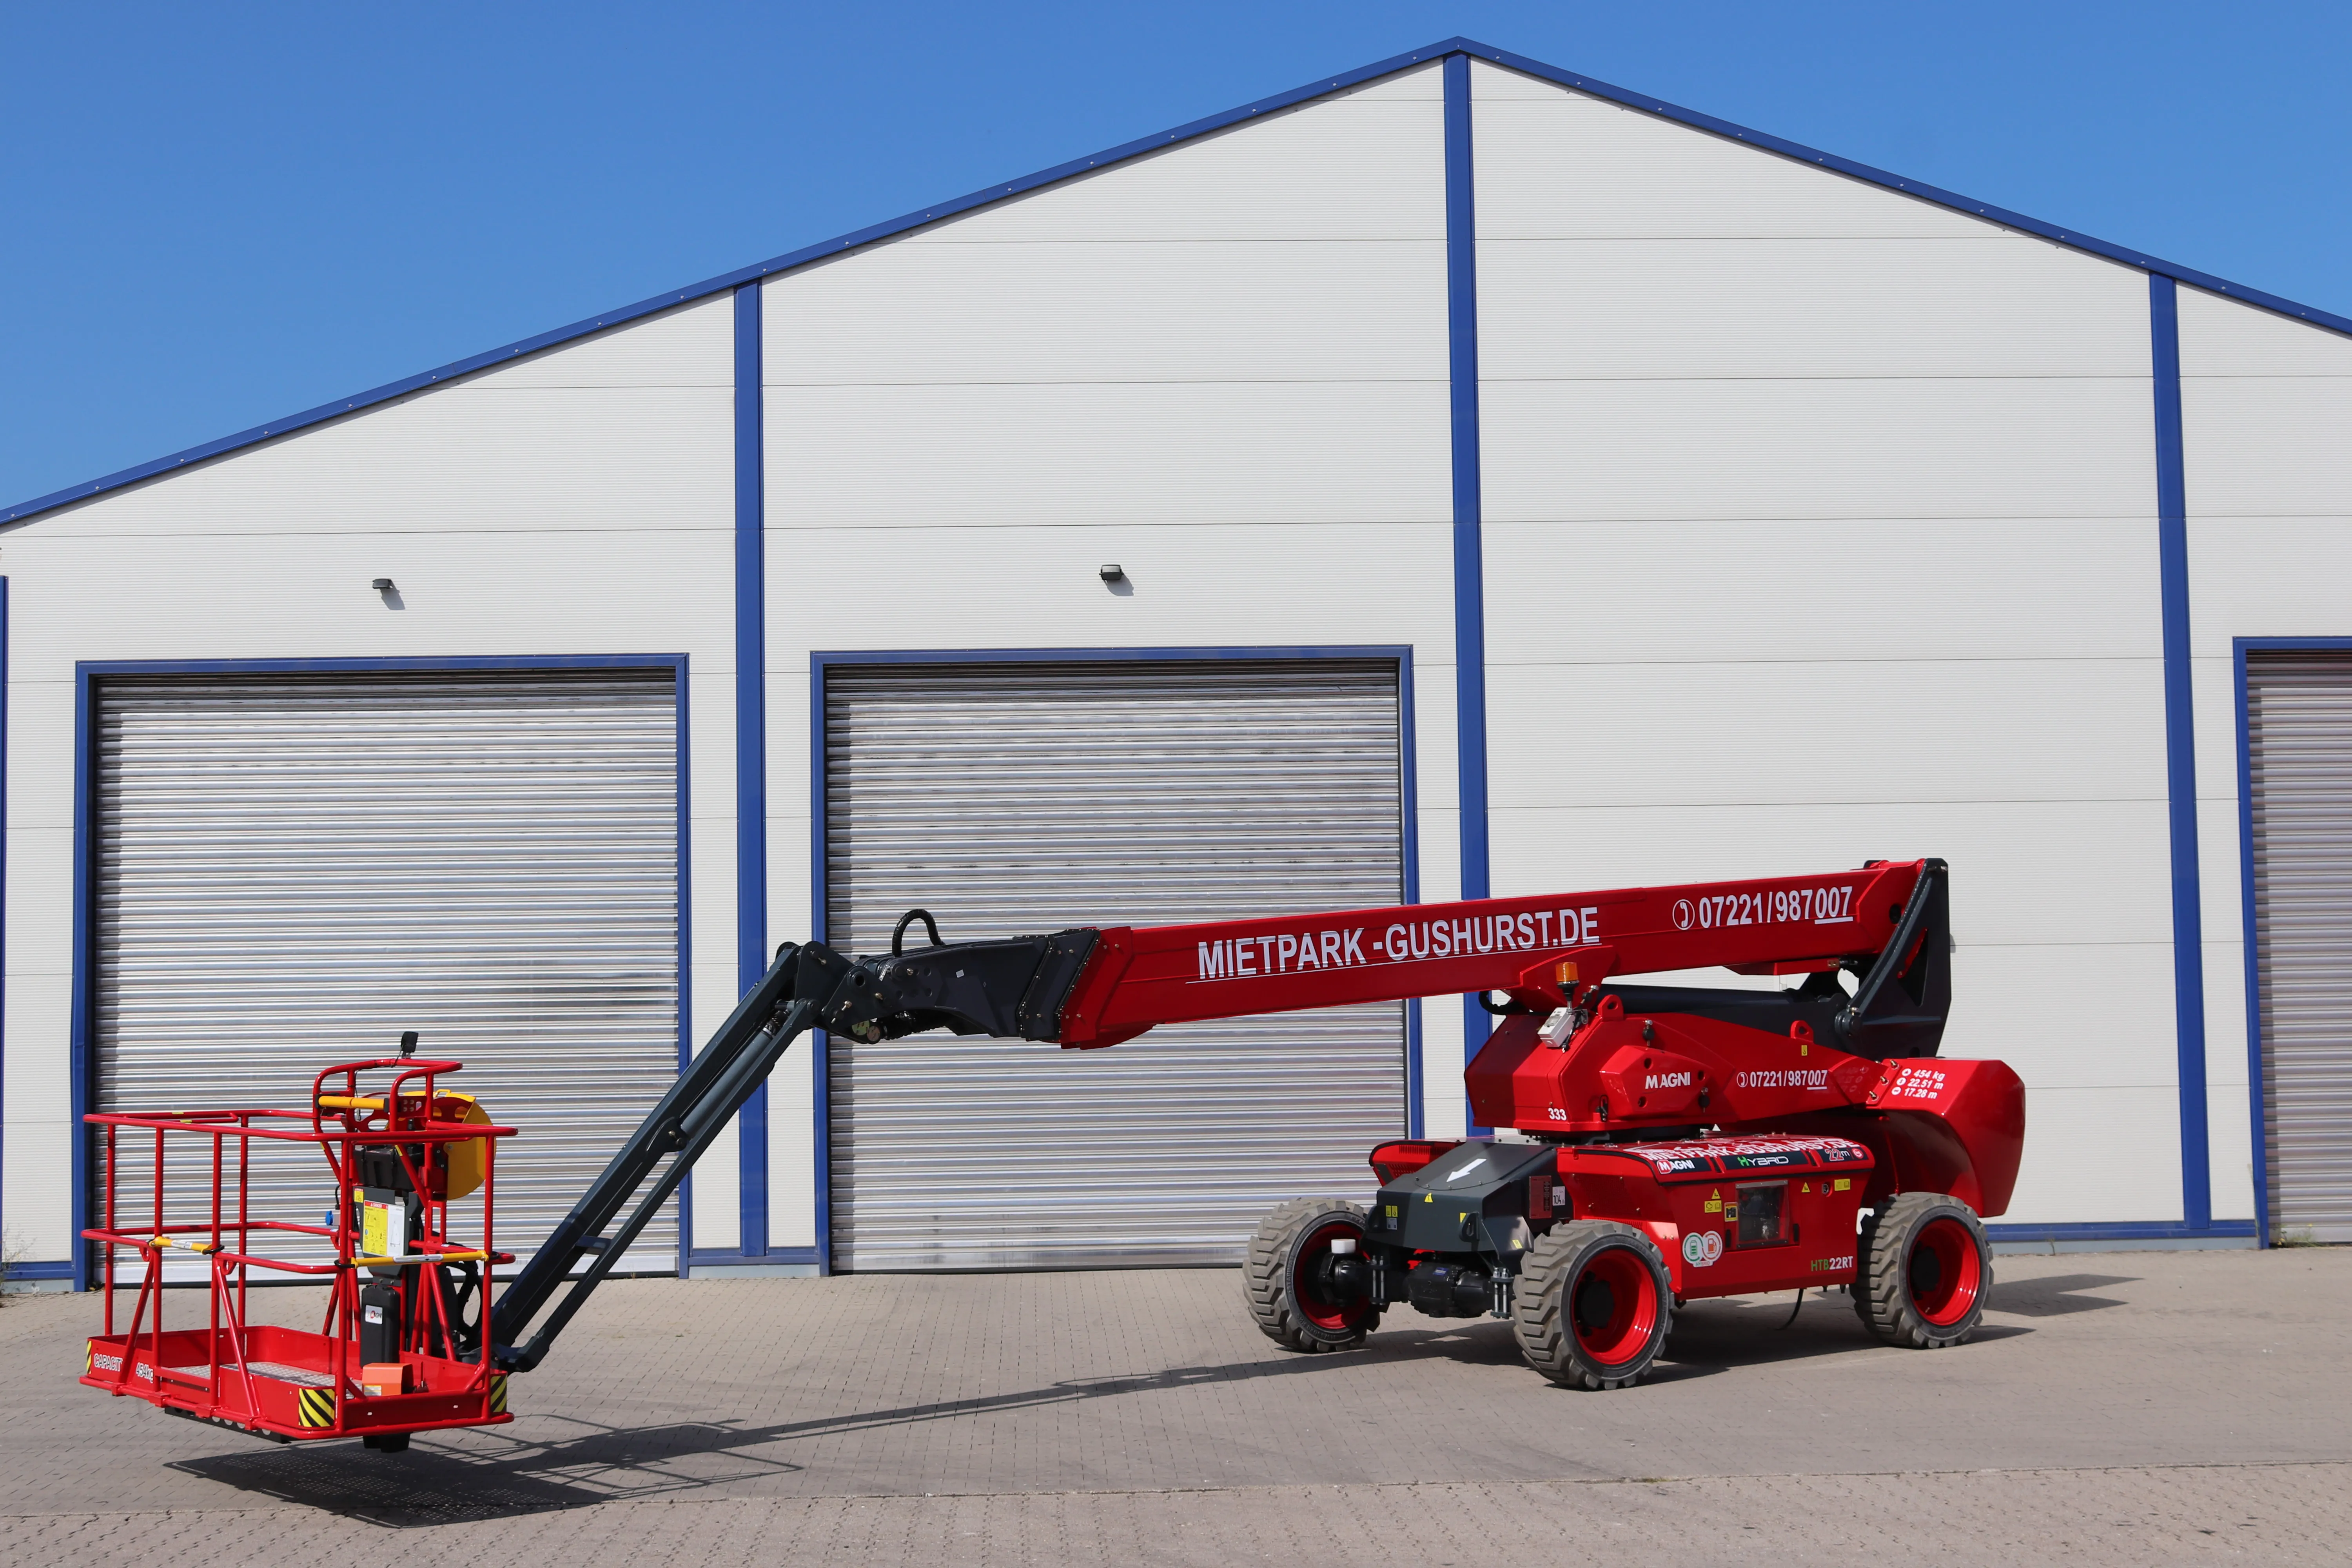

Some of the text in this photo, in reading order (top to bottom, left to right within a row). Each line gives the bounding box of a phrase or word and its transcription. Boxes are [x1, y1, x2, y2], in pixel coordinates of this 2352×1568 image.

[1699, 886, 1853, 929] 07221/987007
[1645, 1072, 1690, 1089] MAGNI
[1750, 1070, 1828, 1087] 07221/987007
[1913, 1069, 1945, 1082] 454 kg
[1907, 1078, 1933, 1088] 22.51
[1904, 1087, 1928, 1098] 17.28
[1548, 1108, 1567, 1121] 333
[1658, 1159, 1695, 1172] MAGNI
[1737, 1156, 1789, 1167] HYBRID
[1811, 1256, 1853, 1271] HTB22RT
[94, 1353, 123, 1372] CAPACIT
